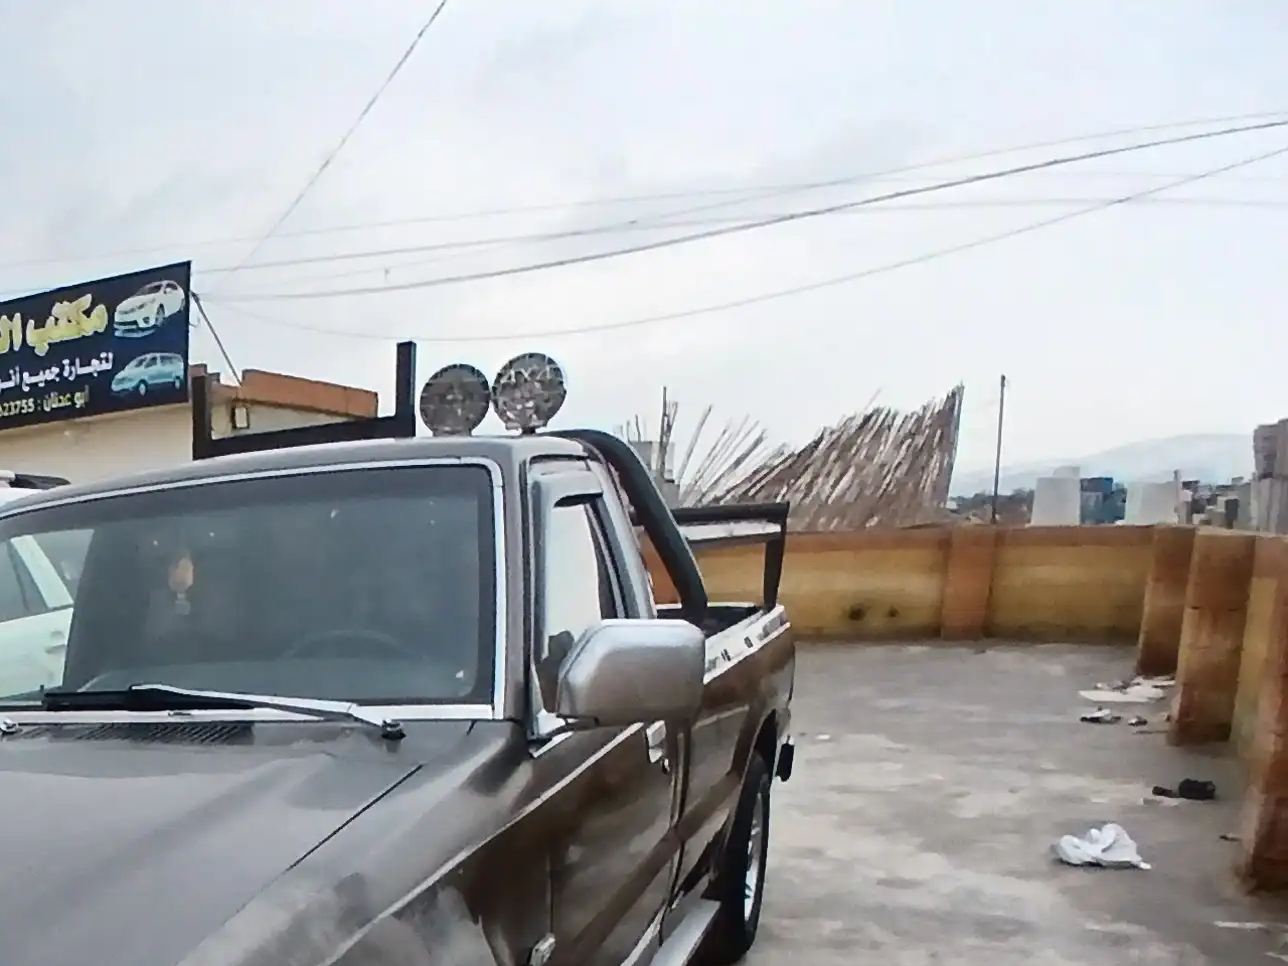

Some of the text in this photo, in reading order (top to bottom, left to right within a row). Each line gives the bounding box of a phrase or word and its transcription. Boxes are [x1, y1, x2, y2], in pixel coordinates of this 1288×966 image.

[26, 293, 109, 357] مكتب
[22, 365, 60, 392] جميع
[62, 351, 114, 381] لتجارة
